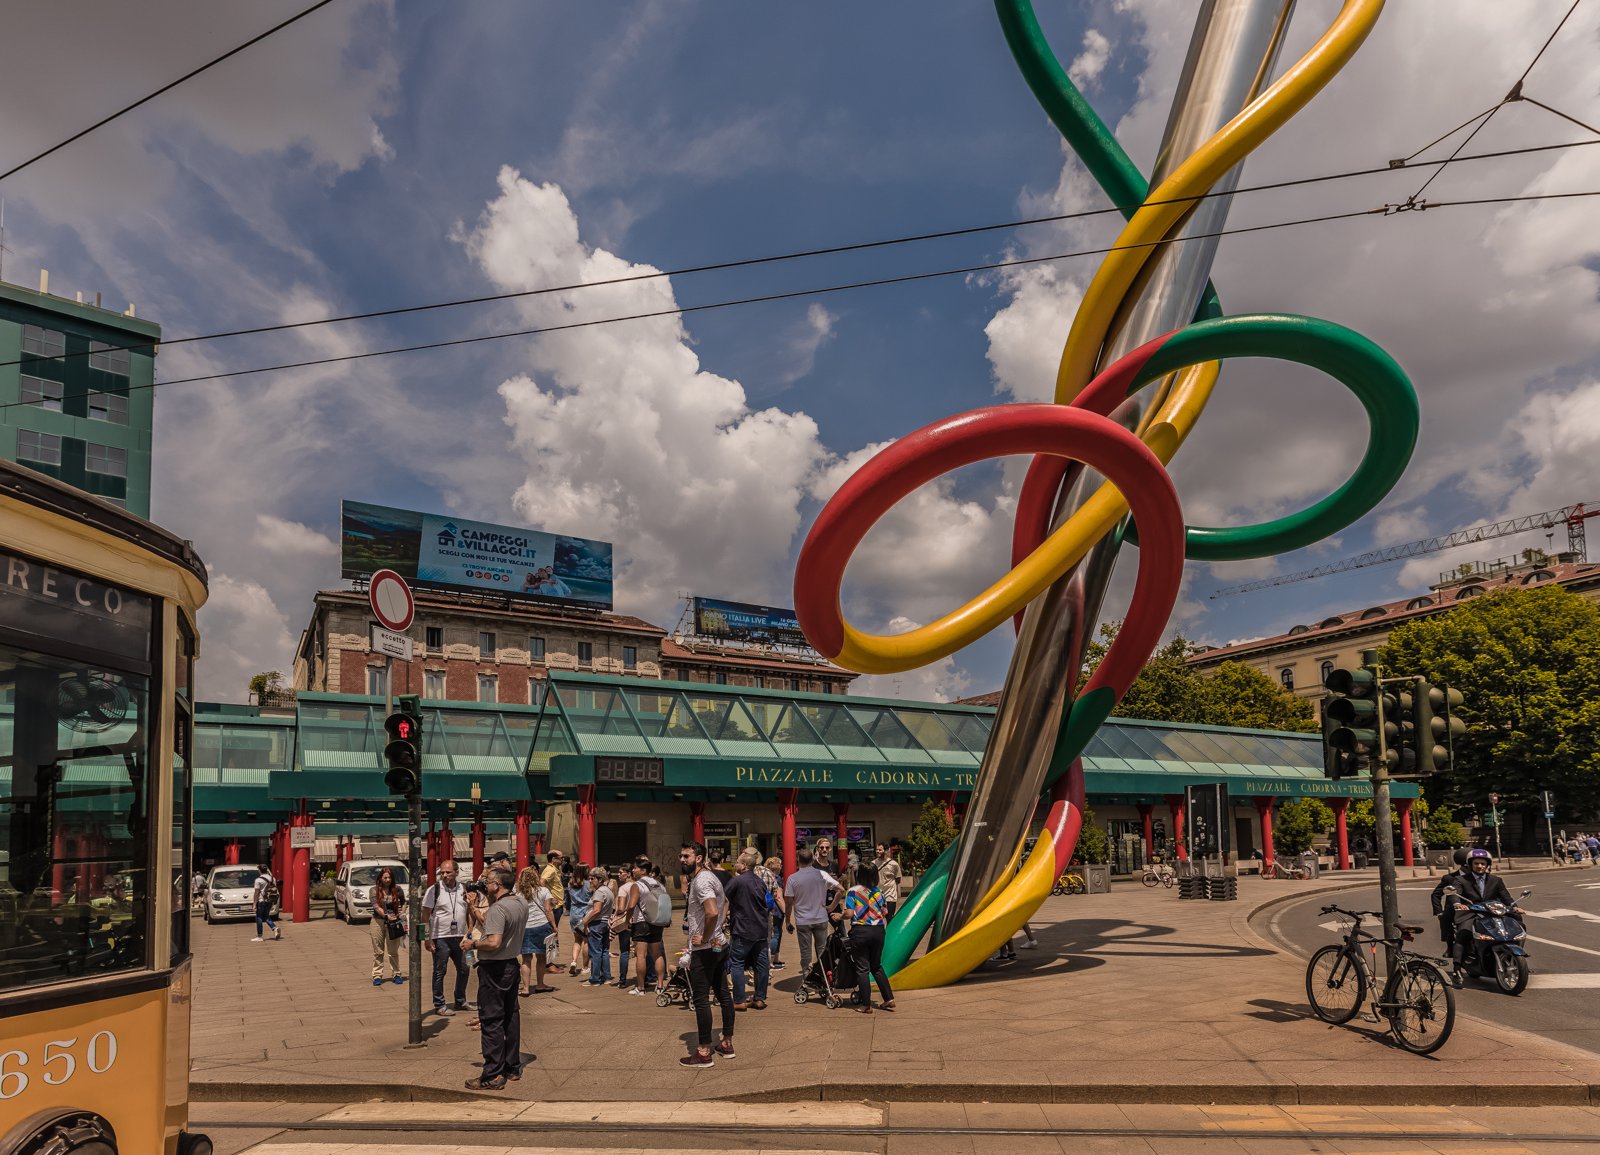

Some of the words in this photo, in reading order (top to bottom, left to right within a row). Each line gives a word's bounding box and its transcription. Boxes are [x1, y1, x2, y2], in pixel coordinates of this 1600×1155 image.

[461, 529, 528, 548] CAMPEGGI
[438, 549, 460, 557] SCEGLI
[508, 558, 535, 568] VACANZE
[457, 539, 537, 559] &VILLAGGI.IT
[6, 556, 123, 615] RECO
[704, 610, 728, 620] RADIO
[728, 613, 750, 623] ITALIA
[751, 616, 767, 626] LIVE
[381, 633, 406, 645] eccetto
[735, 766, 833, 783] PIAZZALE
[856, 770, 940, 785] CADORNA
[1246, 782, 1291, 793] PIAZZALE
[1301, 783, 1342, 794] CADORNA
[0, 1030, 118, 1099] 650
